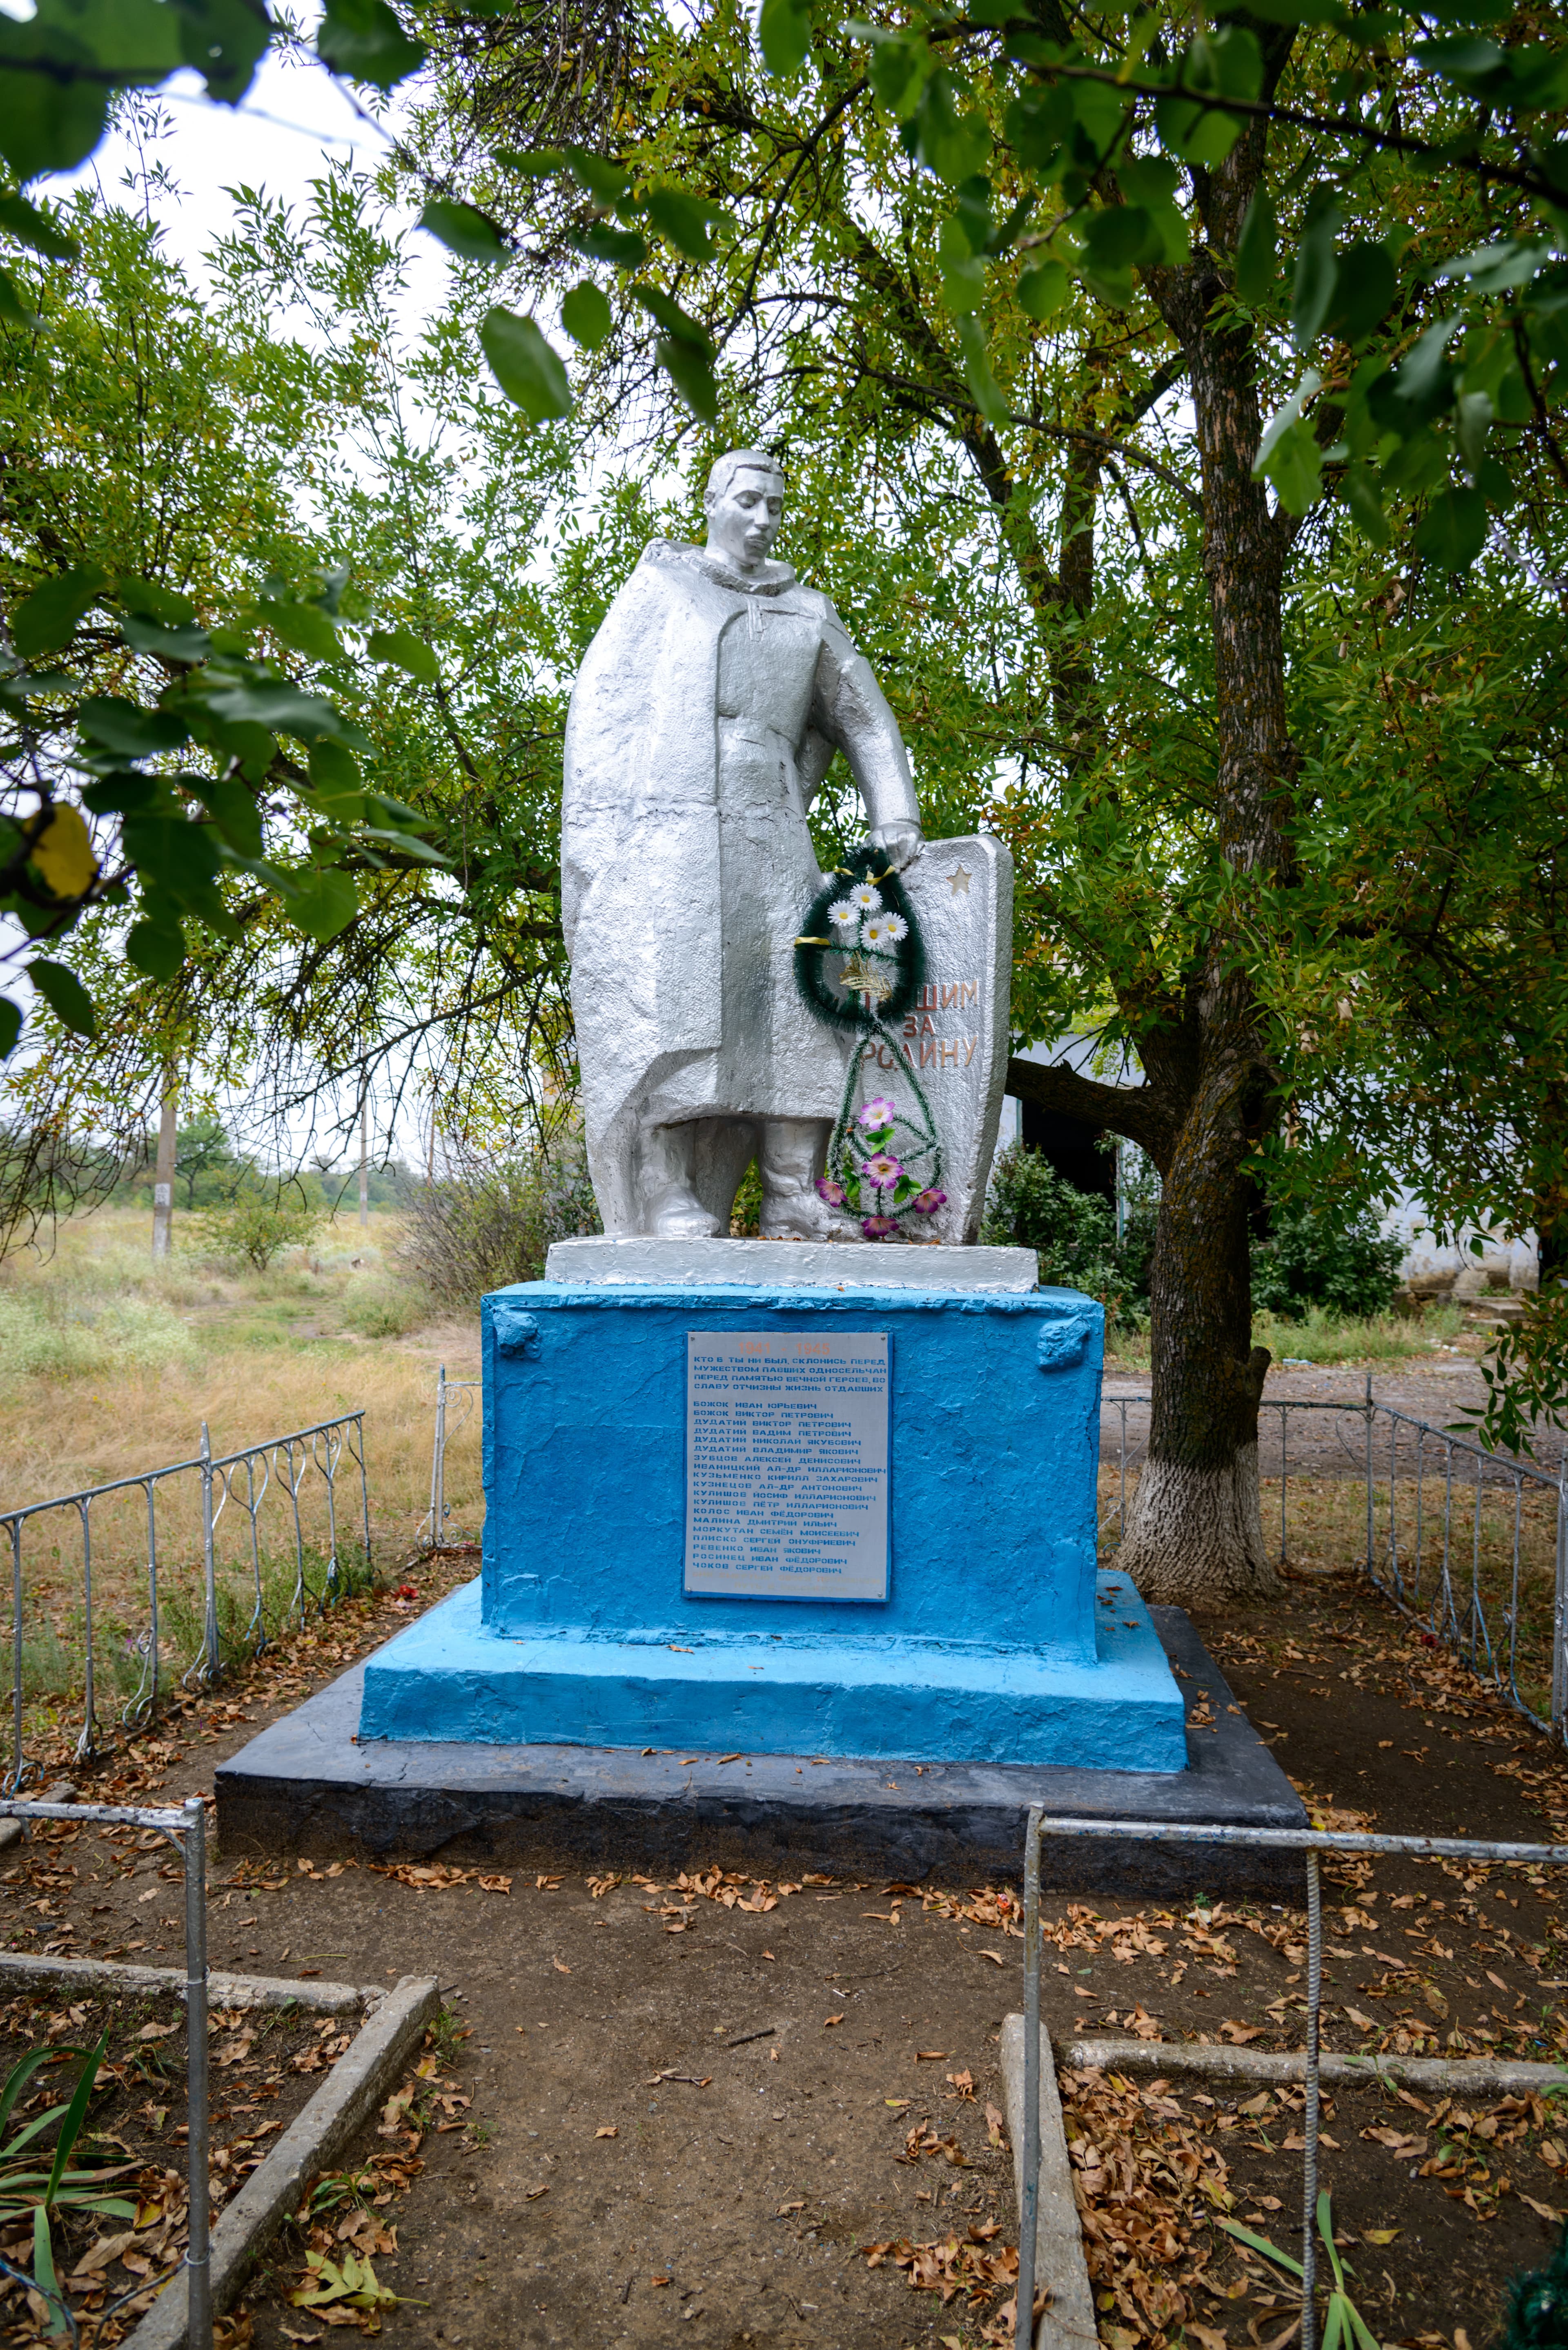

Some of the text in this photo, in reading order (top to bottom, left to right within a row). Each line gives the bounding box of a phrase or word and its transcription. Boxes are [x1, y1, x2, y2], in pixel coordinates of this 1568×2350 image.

[903, 1015, 934, 1037] ЗА
[738, 1341, 770, 1354] 1941
[797, 1342, 830, 1355] 1945
[780, 1565, 842, 1574] ФЁДОРОВИЧ
